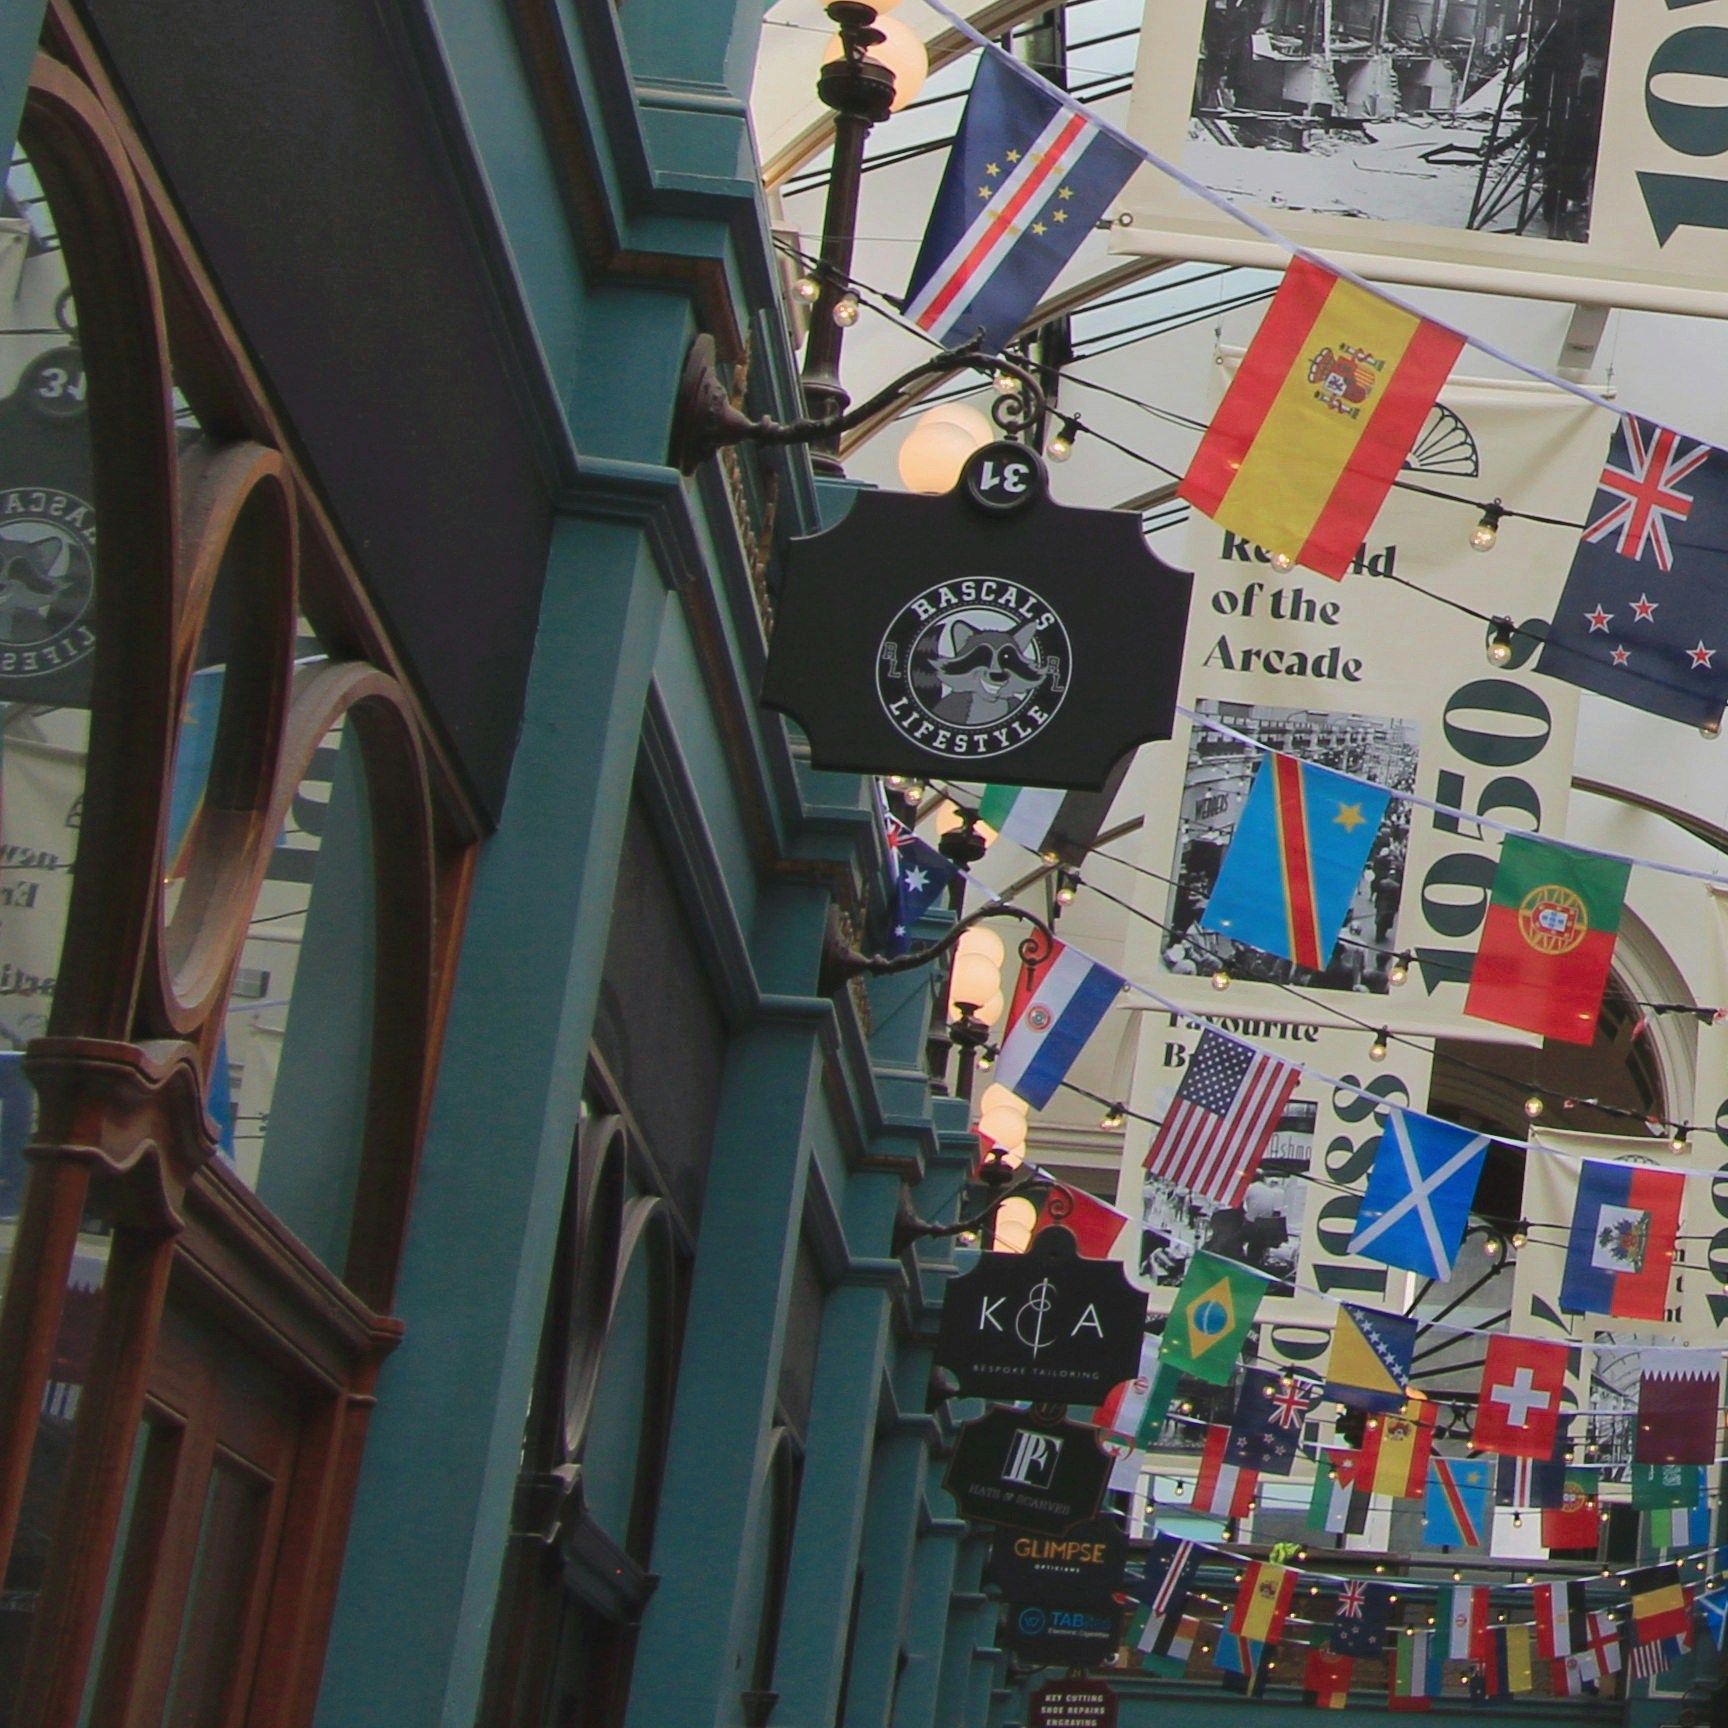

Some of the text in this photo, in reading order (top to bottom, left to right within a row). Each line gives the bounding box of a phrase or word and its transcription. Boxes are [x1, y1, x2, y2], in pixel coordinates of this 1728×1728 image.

[911, 581, 1055, 631] RASCALS
[1211, 583, 1341, 626] of the
[1203, 634, 1363, 683] Arcade
[889, 697, 1049, 752] LIFESTYLE
[979, 1296, 1007, 1332] K
[1070, 1303, 1104, 1339] A
[972, 1364, 1100, 1381] BESPOKE TAILORING
[1014, 1538, 1106, 1564] GLIMPSE
